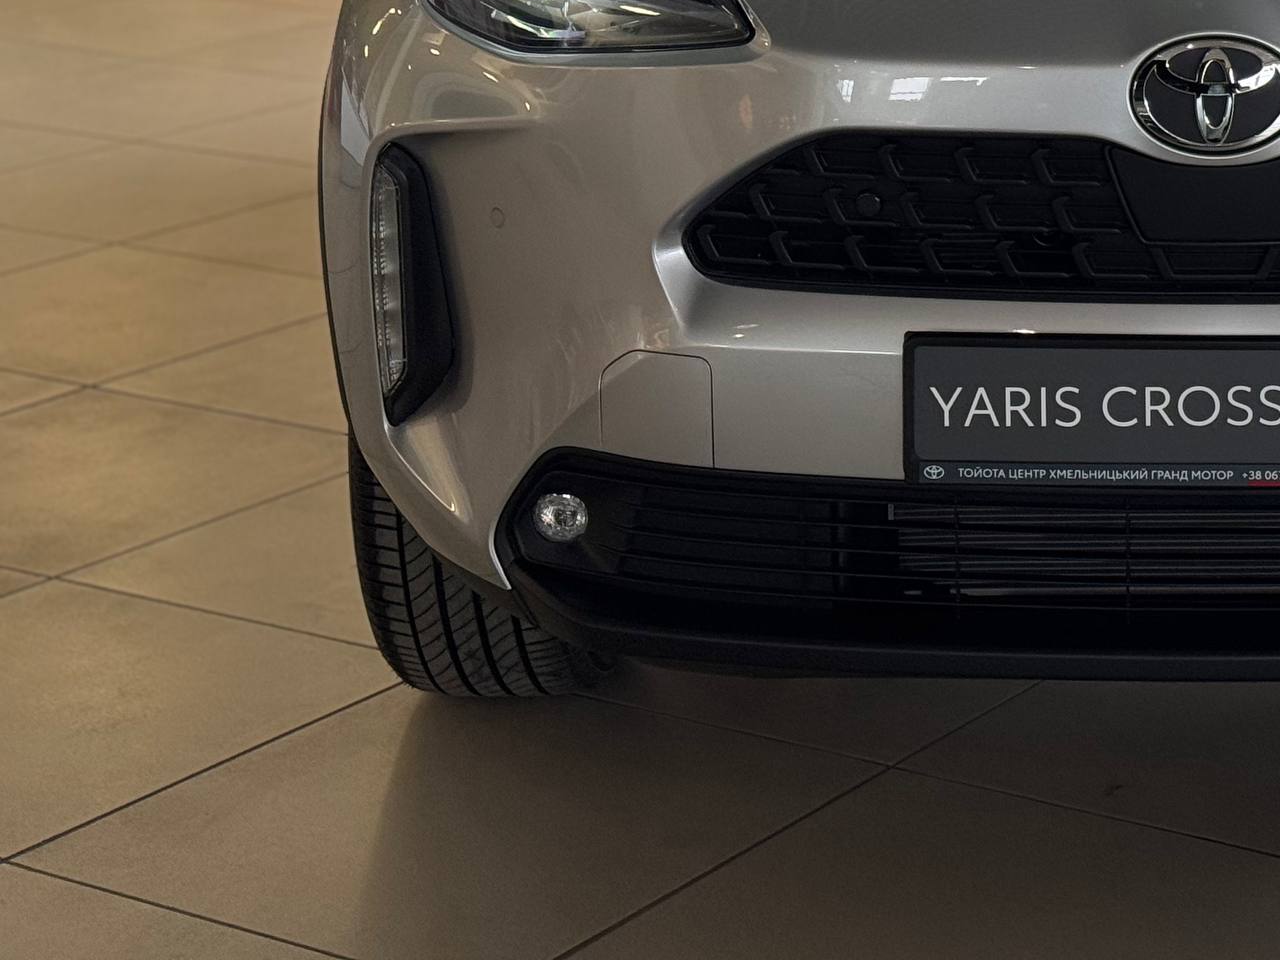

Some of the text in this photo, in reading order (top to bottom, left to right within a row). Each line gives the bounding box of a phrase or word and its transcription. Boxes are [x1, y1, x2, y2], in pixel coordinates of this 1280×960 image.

[929, 386, 1082, 428] YARIS
[957, 466, 1006, 479] ТОЙОТА
[1008, 468, 1047, 480] ЦЕНТР
[1049, 467, 1148, 481] ХМЕЛЬНИЦЬКИЙ
[1151, 470, 1189, 482] ГРАНД
[1191, 470, 1234, 481] МОТОР
[1242, 470, 1262, 481] +38
